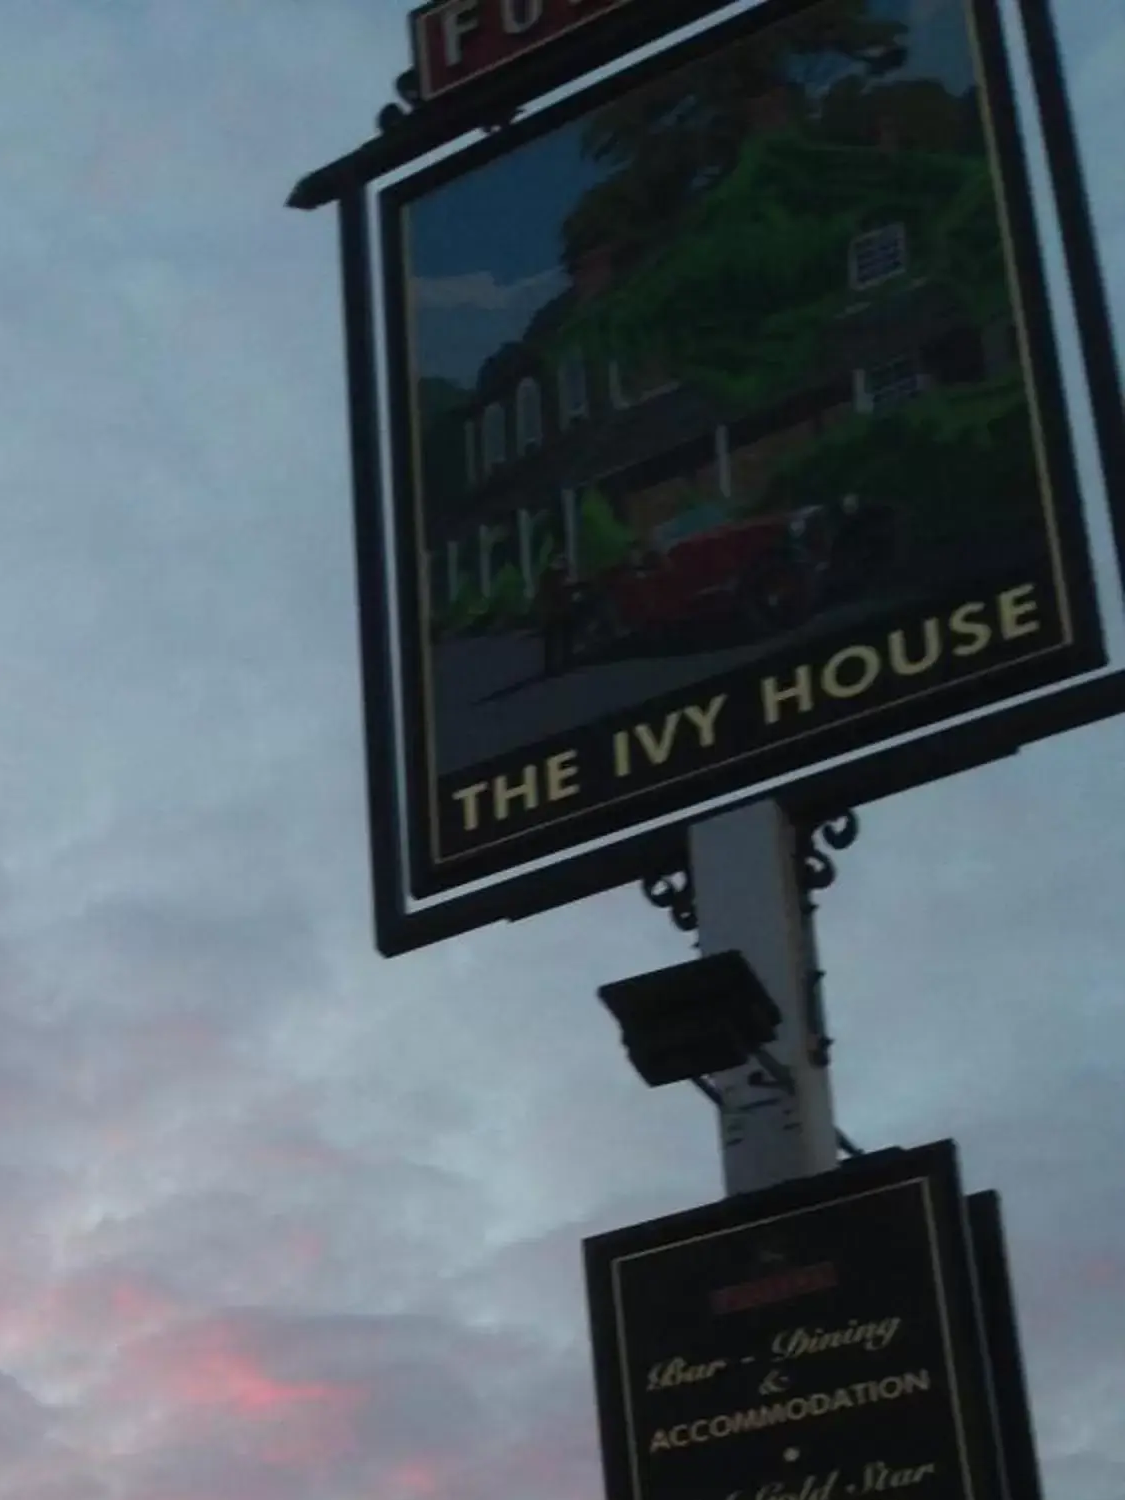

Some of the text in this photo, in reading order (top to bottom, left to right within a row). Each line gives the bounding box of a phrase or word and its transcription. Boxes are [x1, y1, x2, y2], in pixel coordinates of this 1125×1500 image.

[440, 0, 581, 66] FU
[452, 582, 1042, 832] THE IVY HOUSE
[646, 1356, 727, 1391] Bar
[771, 1316, 902, 1361] Dining
[758, 1369, 790, 1395] &
[649, 1369, 931, 1452] ACCOMMODATION
[844, 1459, 935, 1495] Star
